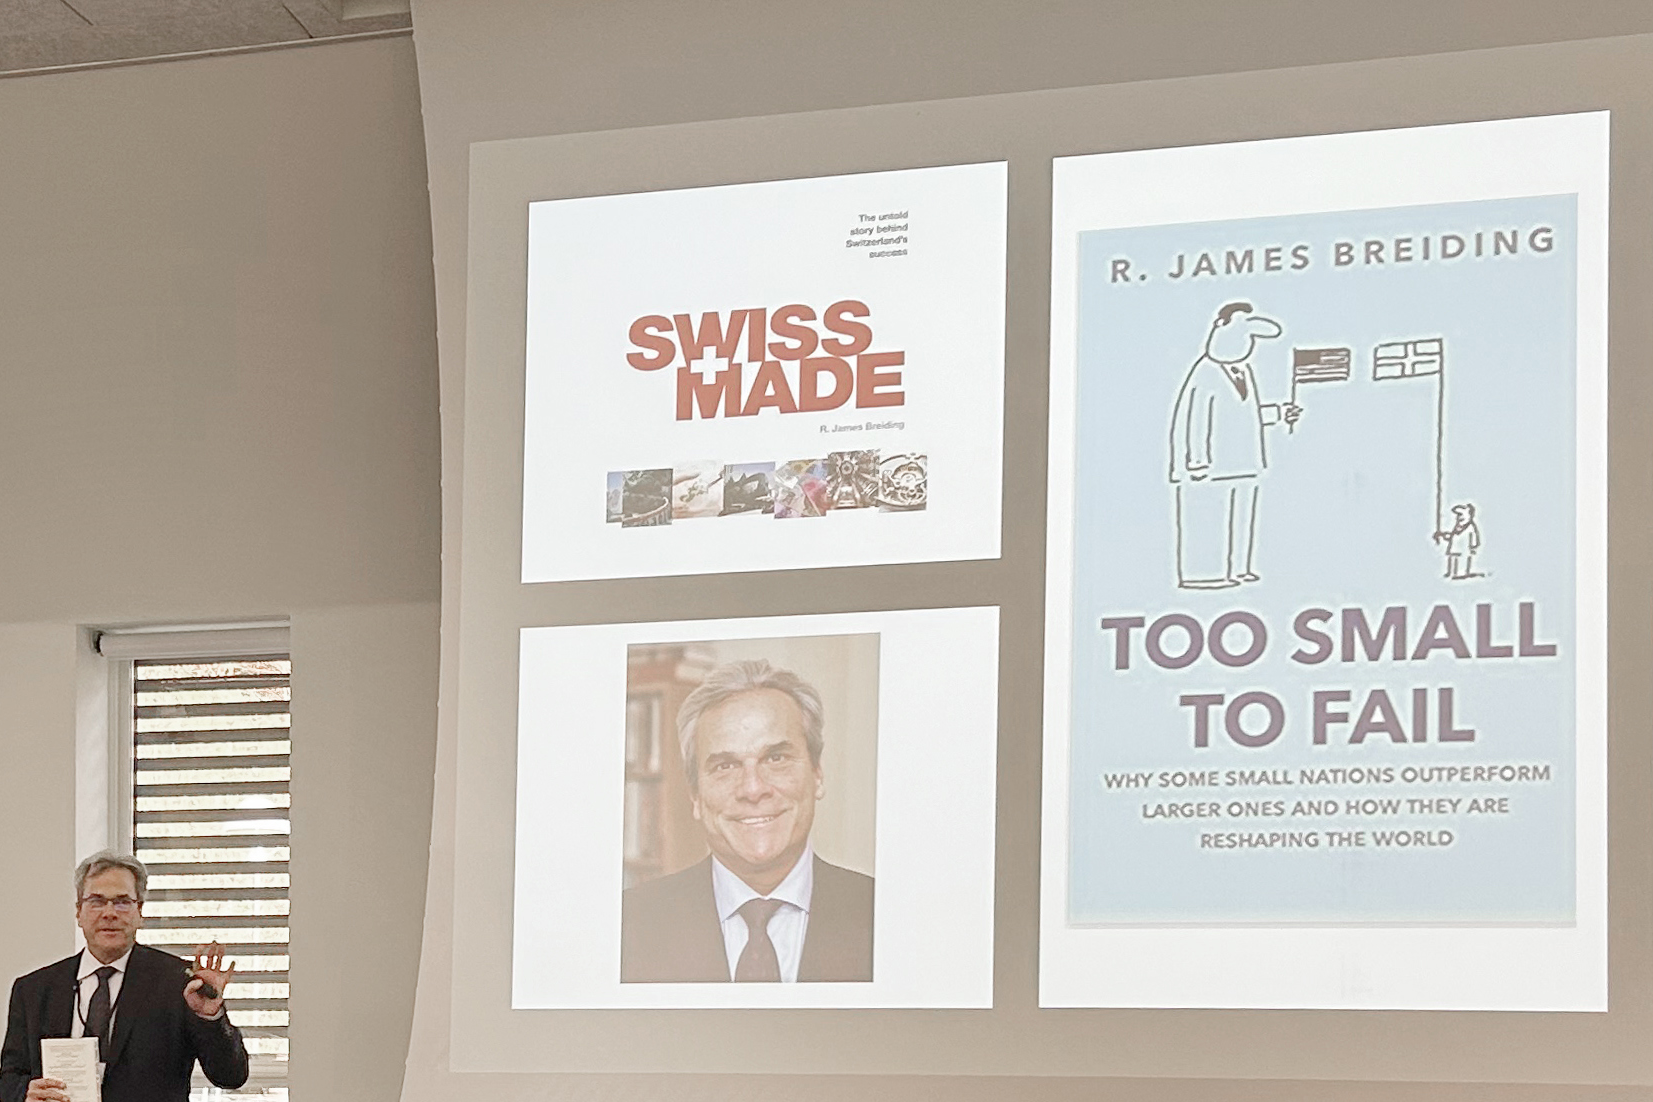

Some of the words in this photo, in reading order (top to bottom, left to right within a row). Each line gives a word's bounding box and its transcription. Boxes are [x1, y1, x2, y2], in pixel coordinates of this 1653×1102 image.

[850, 227, 874, 236] story
[876, 223, 909, 234] behind
[858, 213, 876, 223] The
[878, 210, 909, 222] untold
[1111, 258, 1148, 283] R.
[1169, 245, 1311, 279] JAMES
[1333, 227, 1556, 265] BREIDING
[626, 300, 873, 371] SWISS
[676, 351, 905, 421] MADE
[831, 423, 863, 433] James
[865, 420, 906, 431] Breiding
[1100, 611, 1267, 671] TOO
[1291, 602, 1558, 663] SMALL
[1180, 690, 1286, 749] TO
[1312, 686, 1476, 746] FAIL
[1104, 773, 1155, 790] WHY
[1158, 771, 1220, 788] SOME
[1225, 769, 1295, 786] SMALL
[1299, 767, 1395, 785] NATIONS
[1400, 764, 1552, 783] OUTPERFORM
[1142, 802, 1221, 819] LARGER
[1227, 801, 1285, 818] ONES
[1291, 800, 1339, 817] AND
[1345, 799, 1402, 816] HOW
[1406, 798, 1462, 815] THEY
[1466, 797, 1510, 814] ARE
[1200, 832, 1319, 849] RESHAPING
[1325, 831, 1366, 848] THE
[1371, 830, 1454, 847] WORLD
